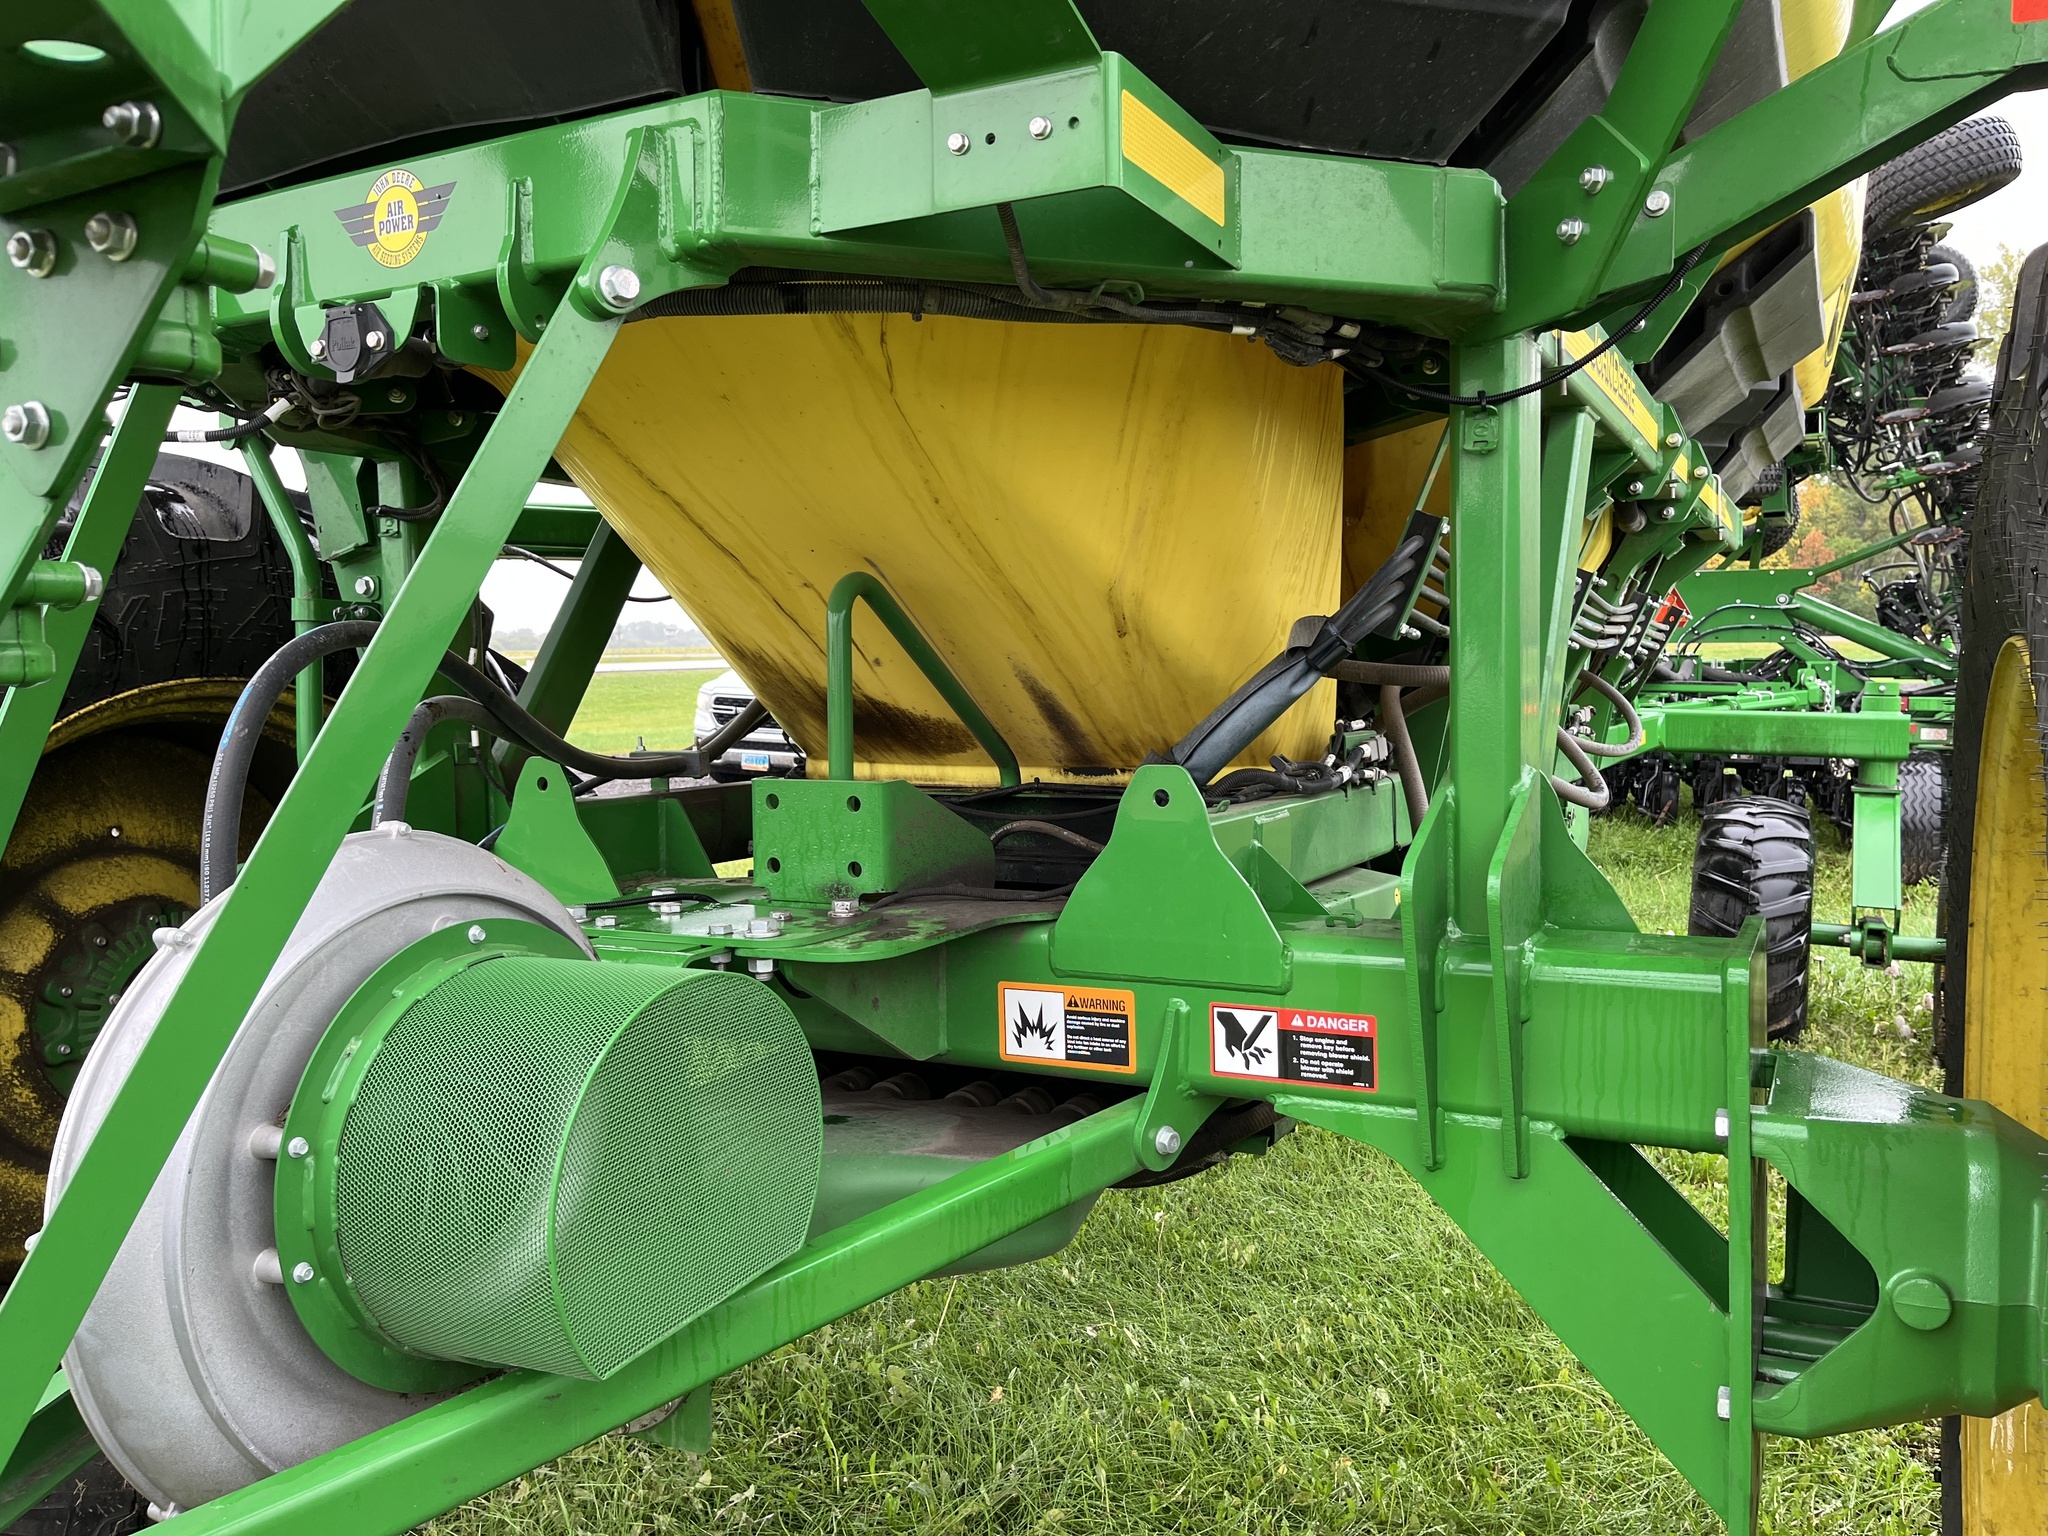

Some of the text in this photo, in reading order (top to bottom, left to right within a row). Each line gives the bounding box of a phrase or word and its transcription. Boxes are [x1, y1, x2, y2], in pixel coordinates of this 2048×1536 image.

[373, 172, 415, 197] JOHN DEERE
[387, 199, 404, 218] AIR
[378, 214, 414, 236] POWER
[371, 234, 424, 266] AIR SEEDING SYSTEMS
[1080, 998, 1126, 1012] WARNING
[1306, 1016, 1368, 1032] DANGER
[1299, 1035, 1314, 1043] Stop
[1314, 1037, 1335, 1045] engine
[1323, 1044, 1334, 1052] key
[1335, 1045, 1356, 1053] before
[1300, 1050, 1371, 1062] removing blower shield.
[1300, 1064, 1320, 1072] blower
[1335, 1068, 1354, 1076] shield
[1321, 1060, 1344, 1068] operate
[1300, 1072, 1329, 1080] removed.
